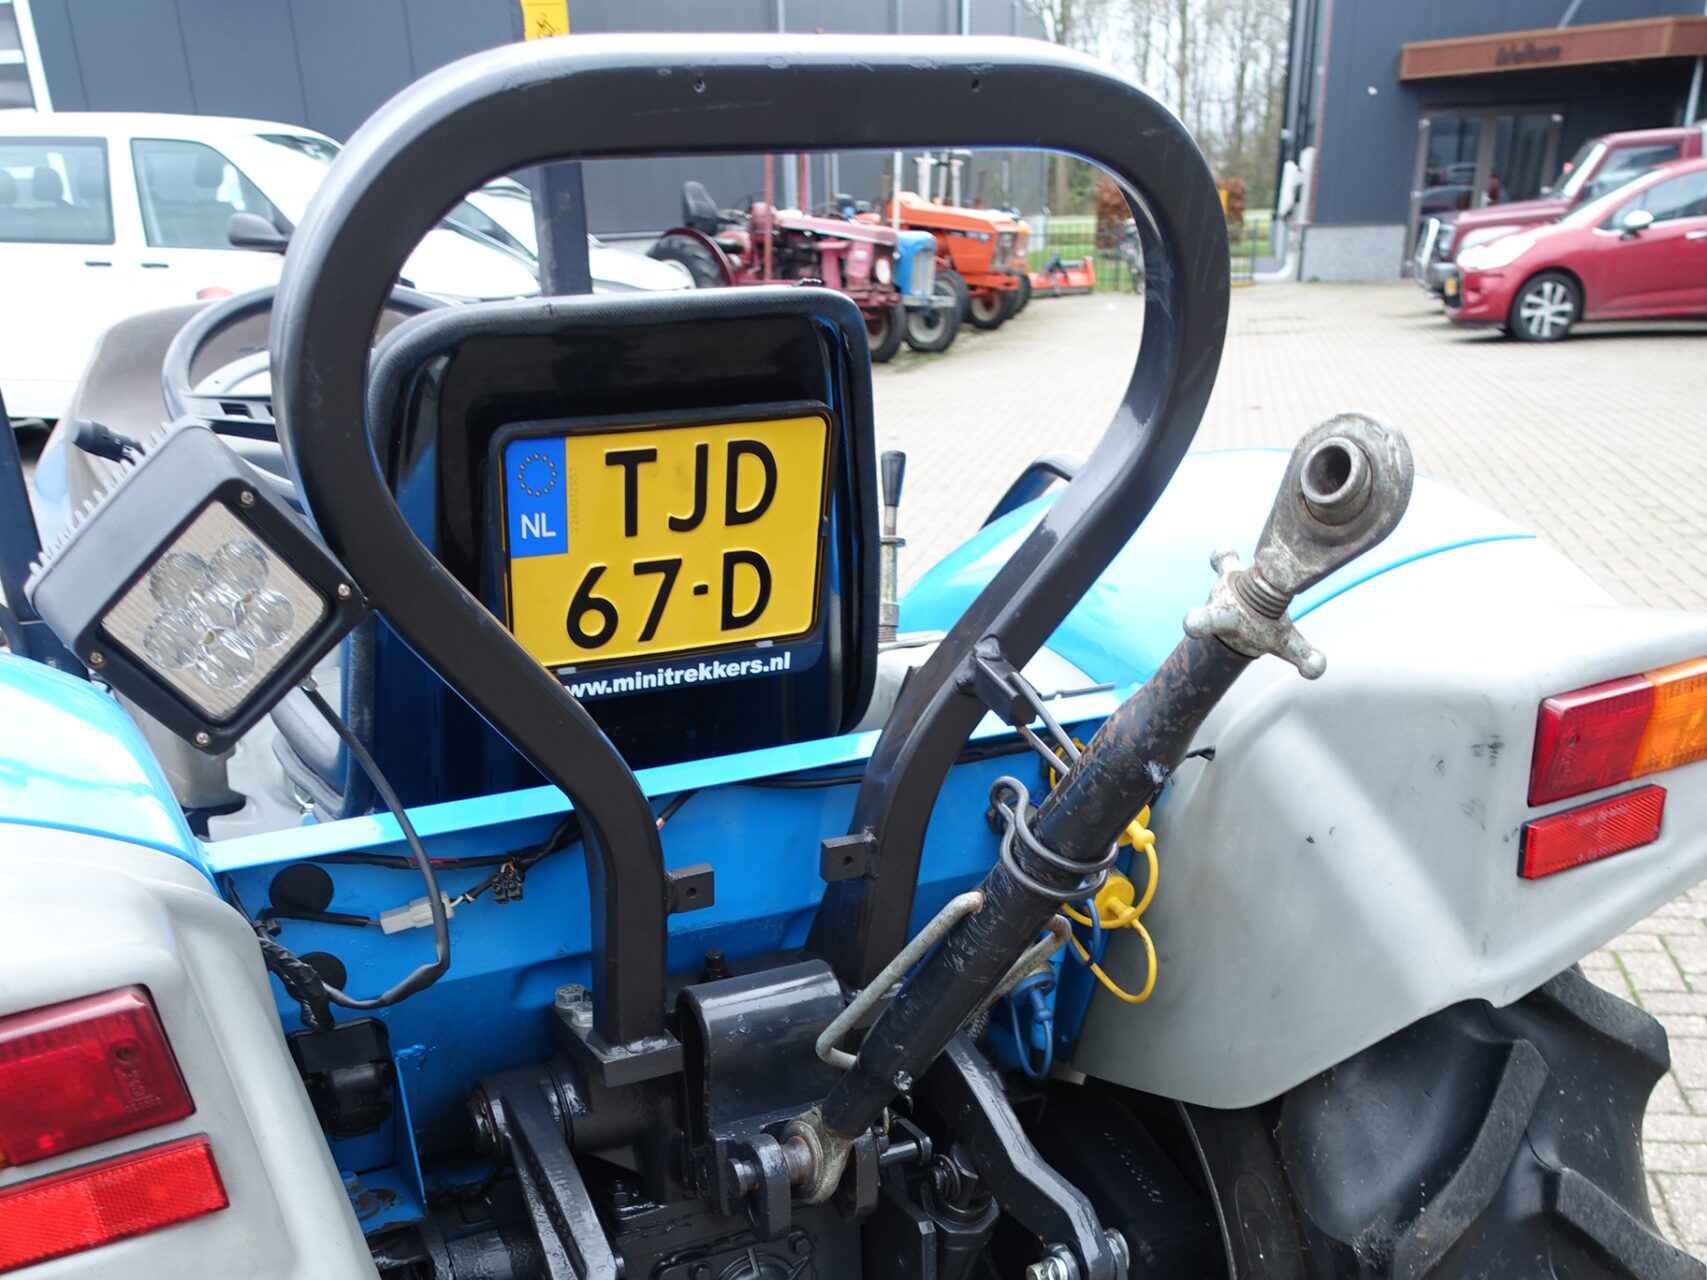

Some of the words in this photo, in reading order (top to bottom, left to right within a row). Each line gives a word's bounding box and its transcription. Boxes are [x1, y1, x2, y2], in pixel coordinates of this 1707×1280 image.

[605, 439, 778, 538] TJD
[520, 512, 557, 540] NL
[565, 549, 773, 650] 67-D
[563, 650, 792, 699] ww.minitrekkers.nl
